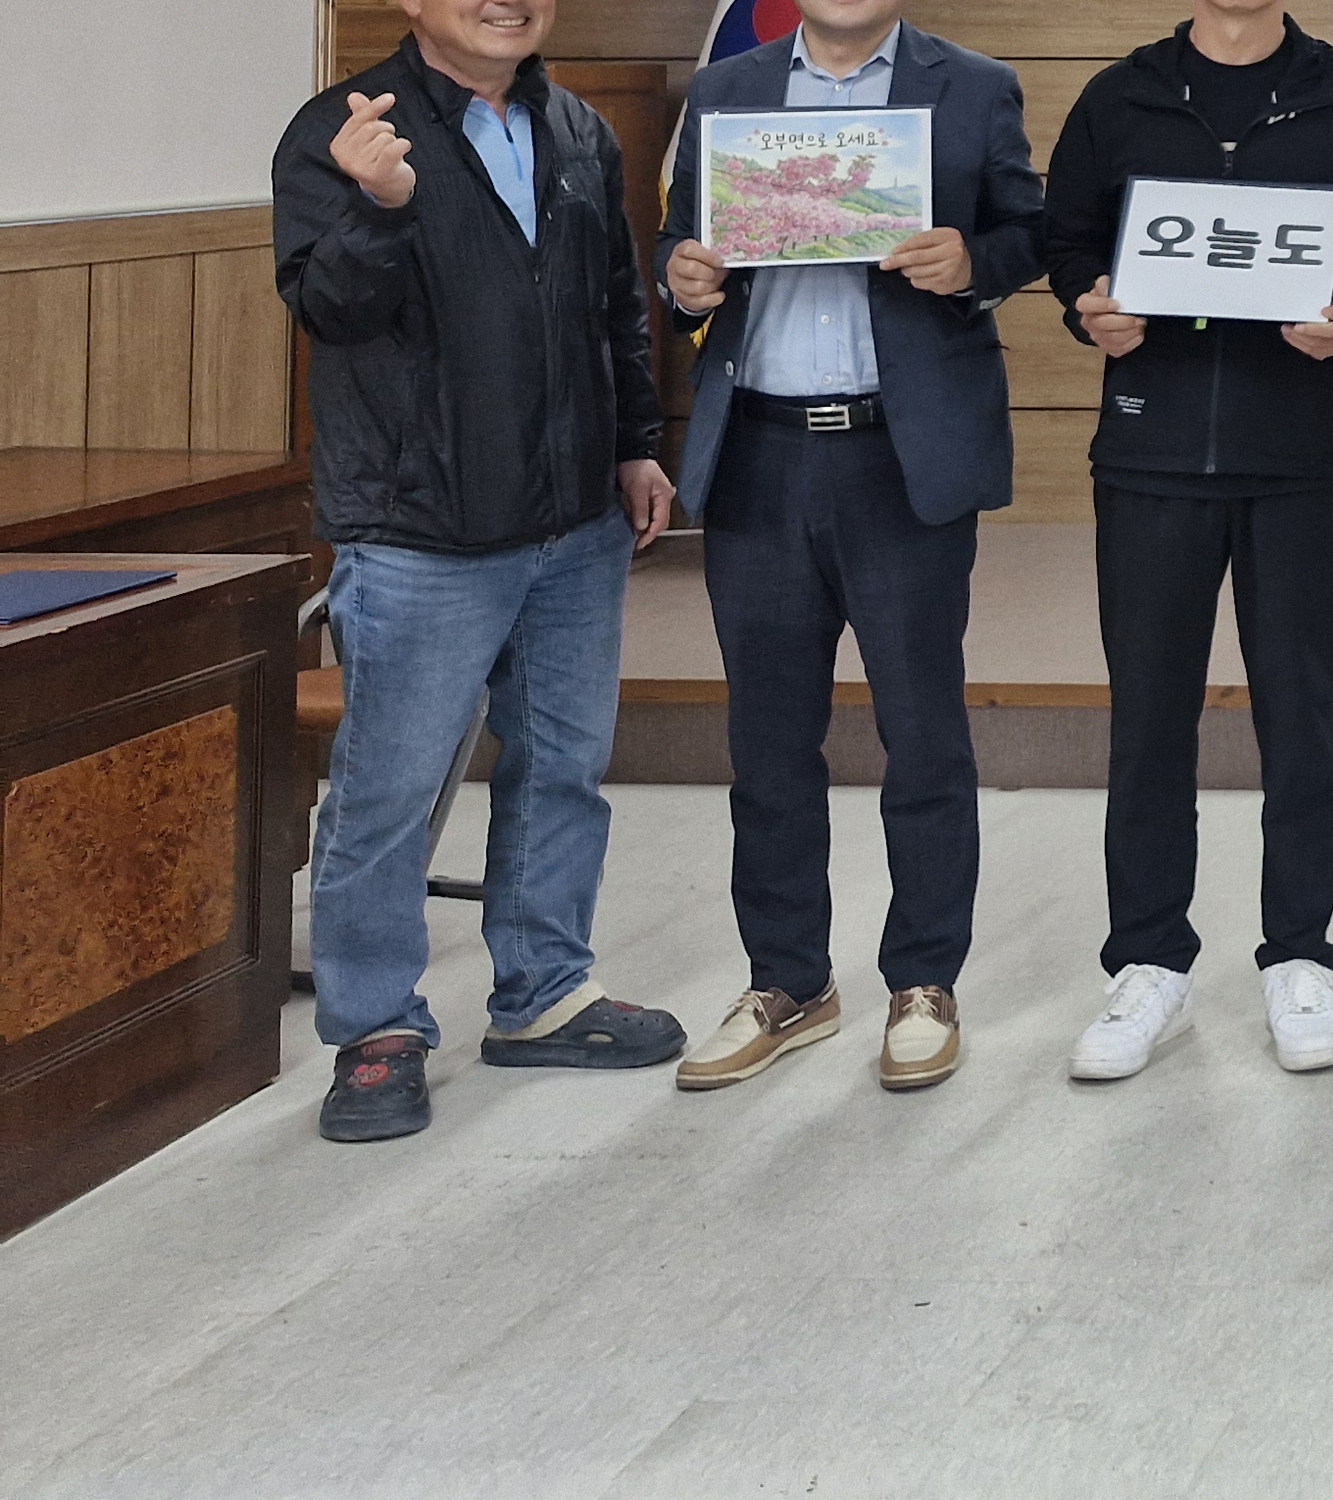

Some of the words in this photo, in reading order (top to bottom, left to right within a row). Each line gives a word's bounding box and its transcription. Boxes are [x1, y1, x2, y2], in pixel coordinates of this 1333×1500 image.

[760, 132, 828, 151] 오부면으로
[835, 131, 879, 148] 오세요
[1138, 215, 1325, 270] 오늘도
